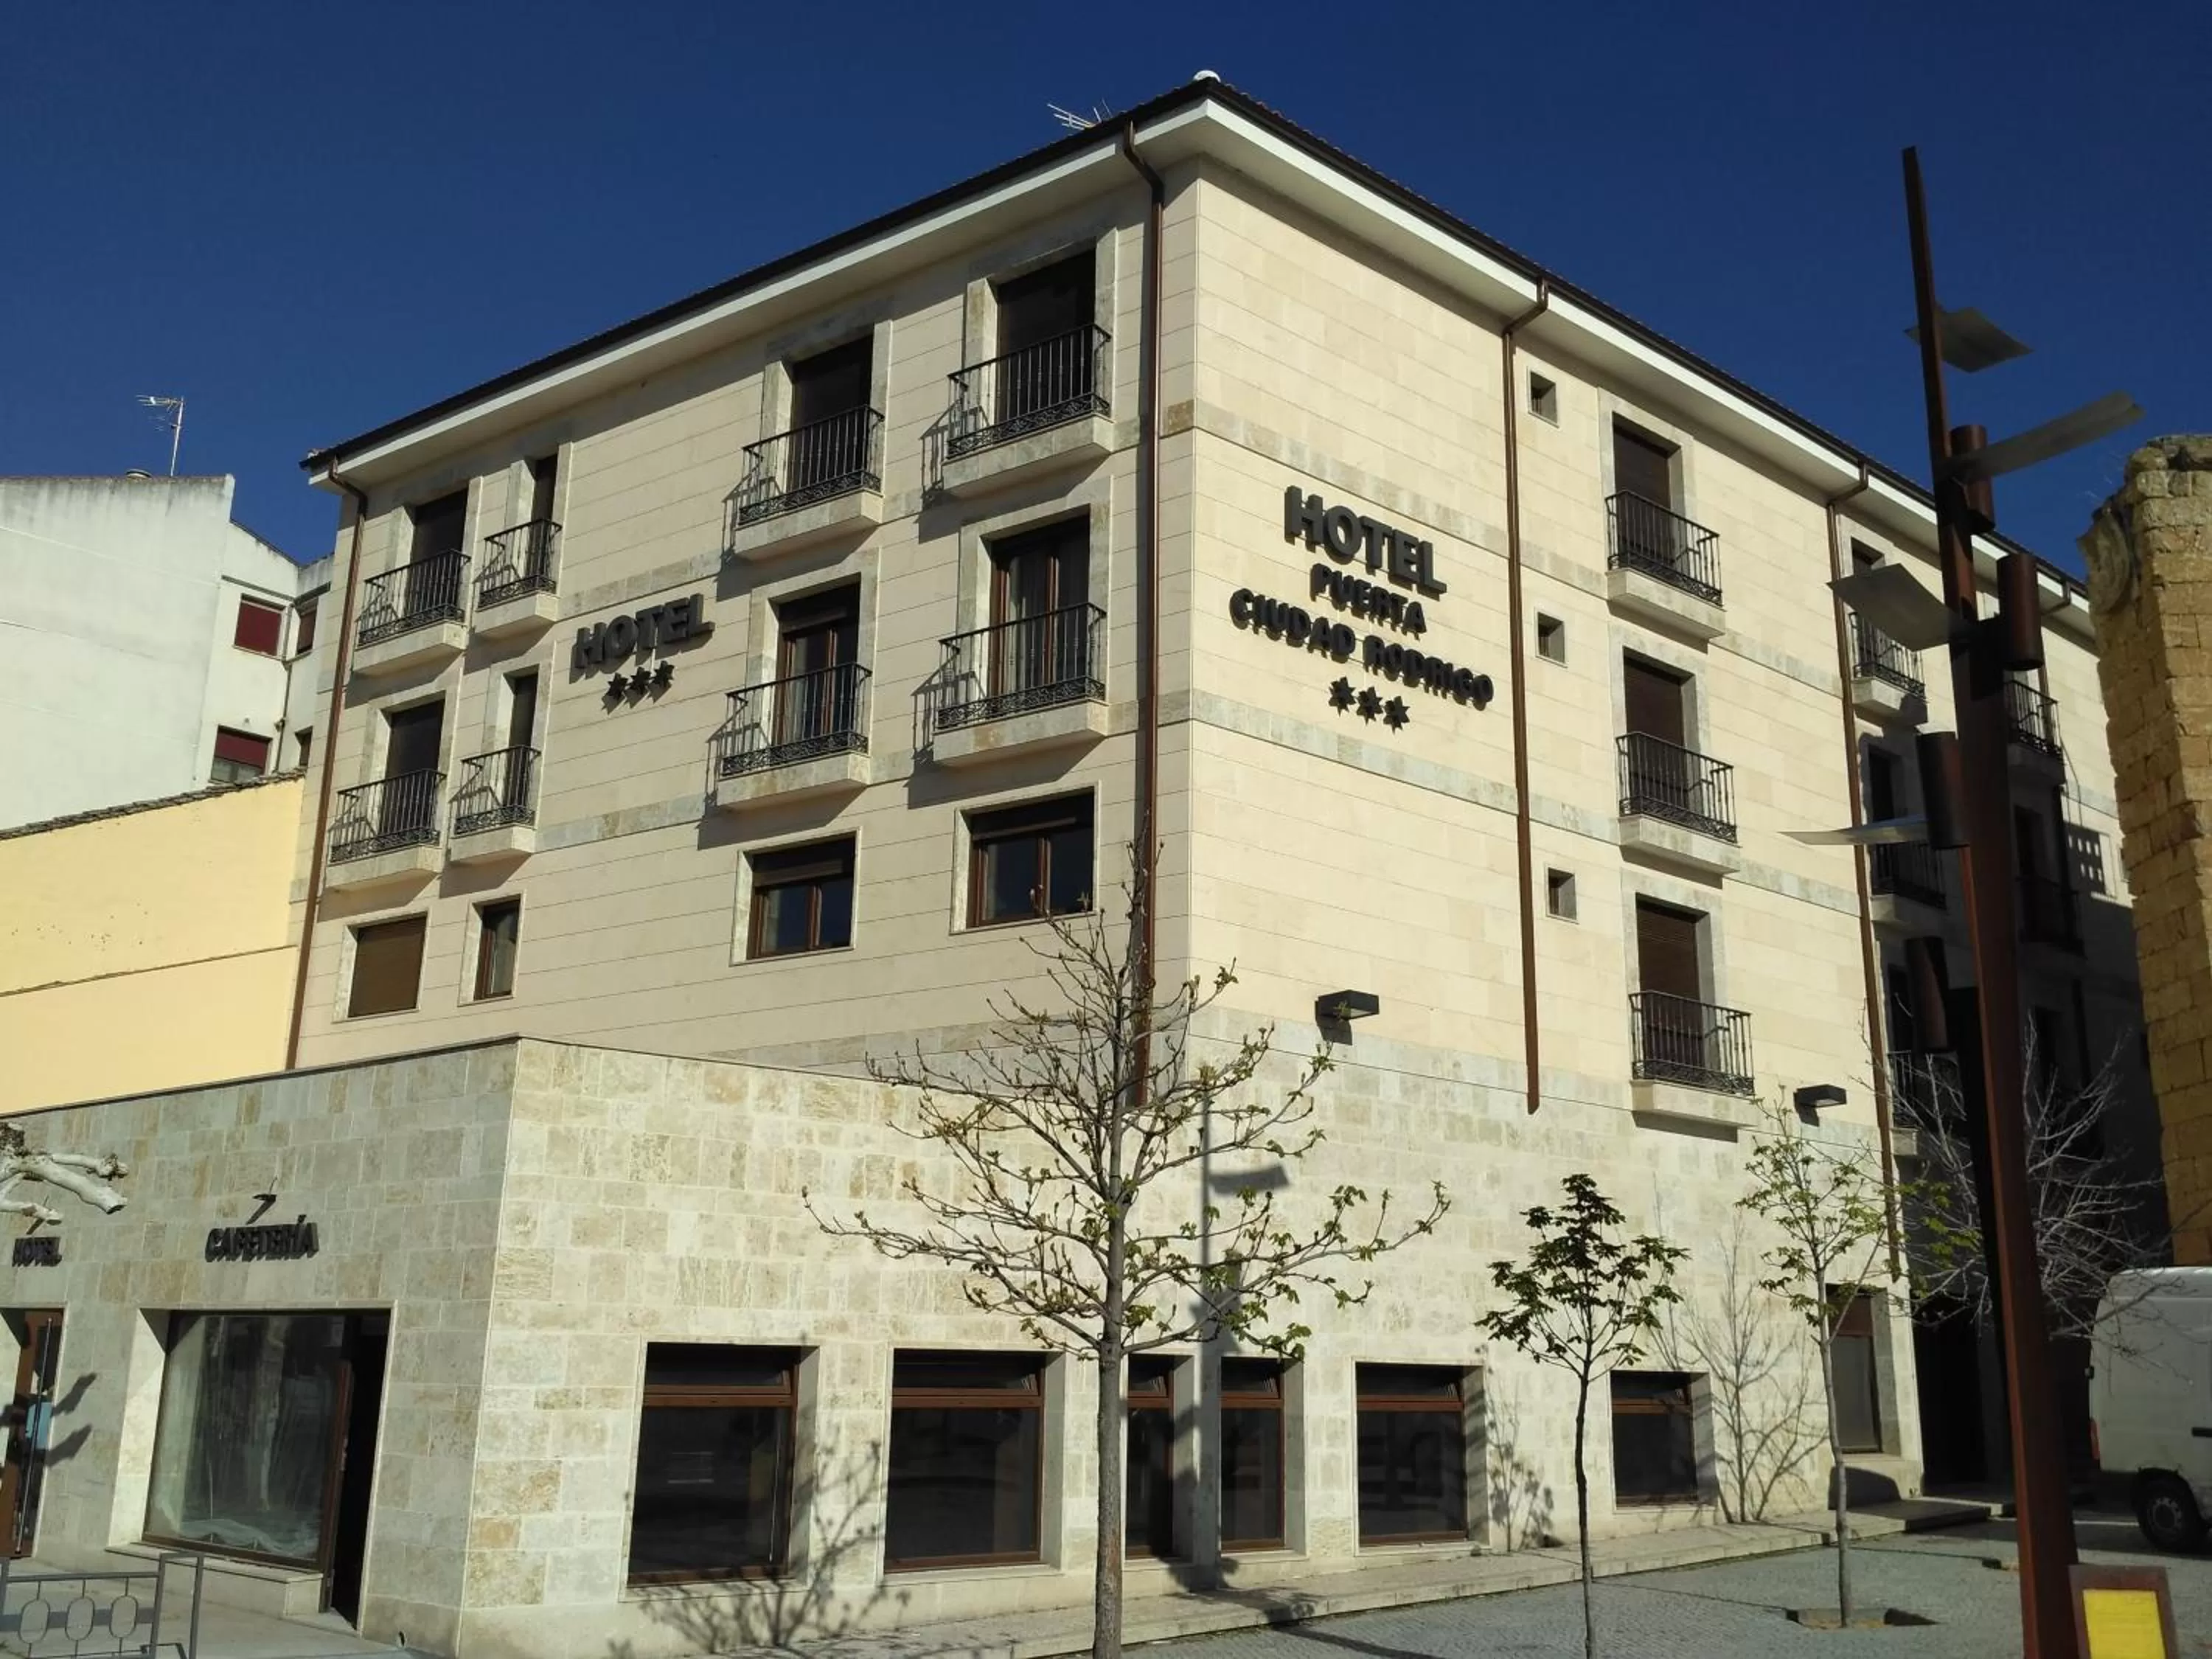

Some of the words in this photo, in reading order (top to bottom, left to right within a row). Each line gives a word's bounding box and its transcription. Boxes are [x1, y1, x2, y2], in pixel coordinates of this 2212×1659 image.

[1284, 485, 1447, 595] HOTEL
[574, 593, 715, 671] HOTEL
[1310, 563, 1427, 635] PUERTA
[1229, 588, 1356, 658] CIUDAD
[1363, 635, 1494, 705] RODRIGO
